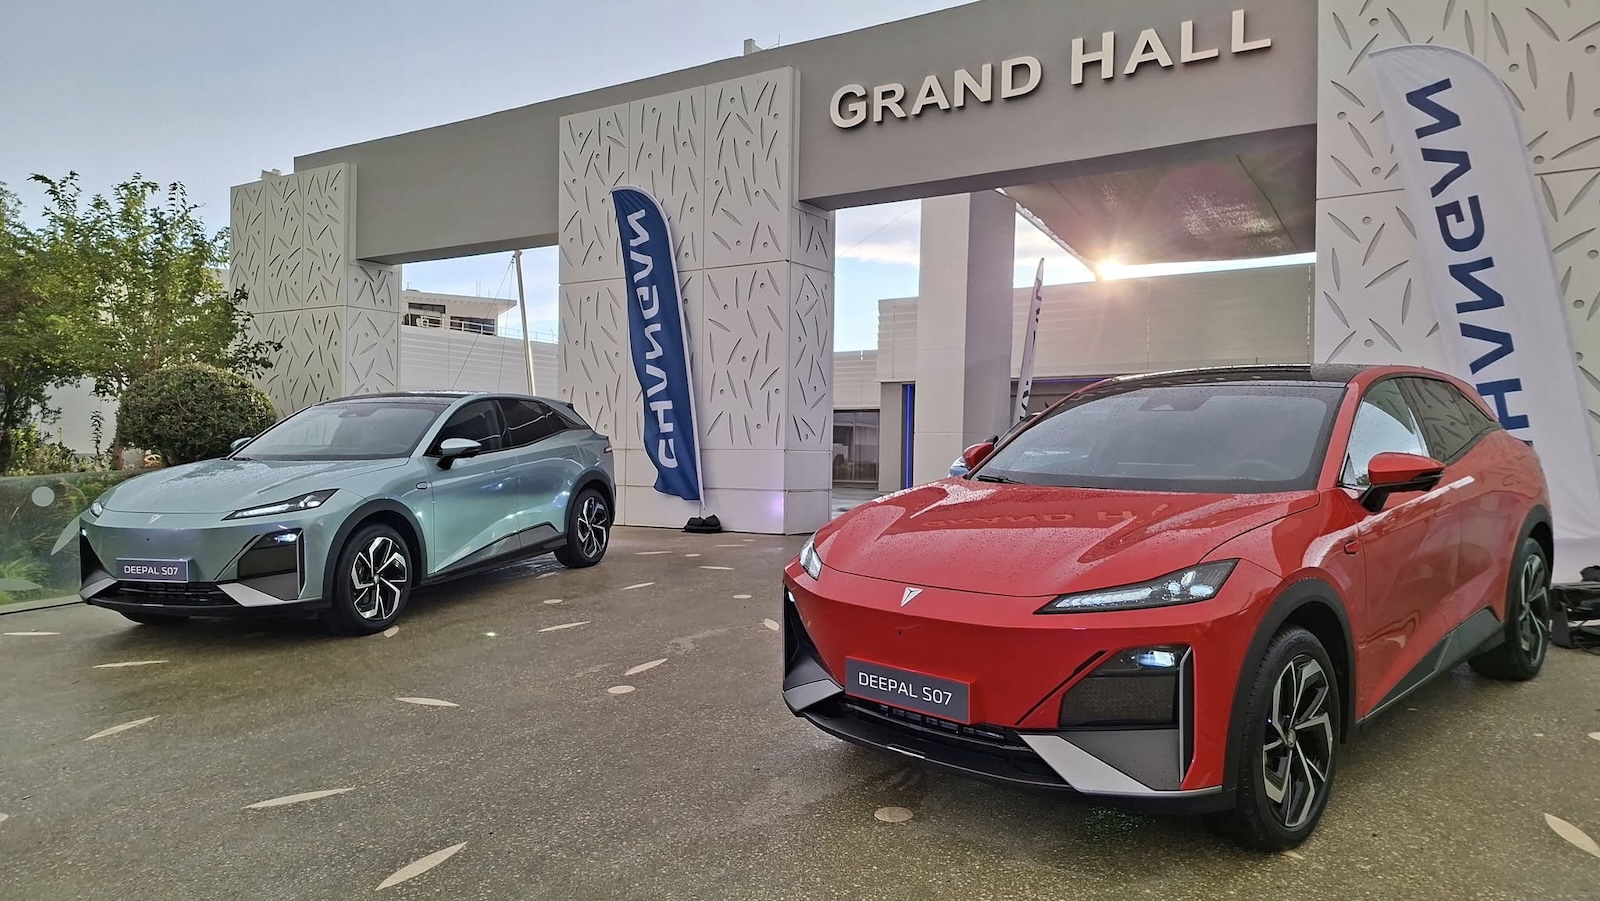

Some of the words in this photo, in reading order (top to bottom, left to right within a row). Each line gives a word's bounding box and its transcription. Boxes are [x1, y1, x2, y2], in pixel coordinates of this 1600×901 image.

[829, 55, 1042, 130] GRAND
[1070, 9, 1273, 86] HALL
[123, 565, 160, 575] DEEPAL
[161, 566, 179, 576] S07
[858, 671, 919, 699] DEEPAL
[922, 686, 953, 706] S07
